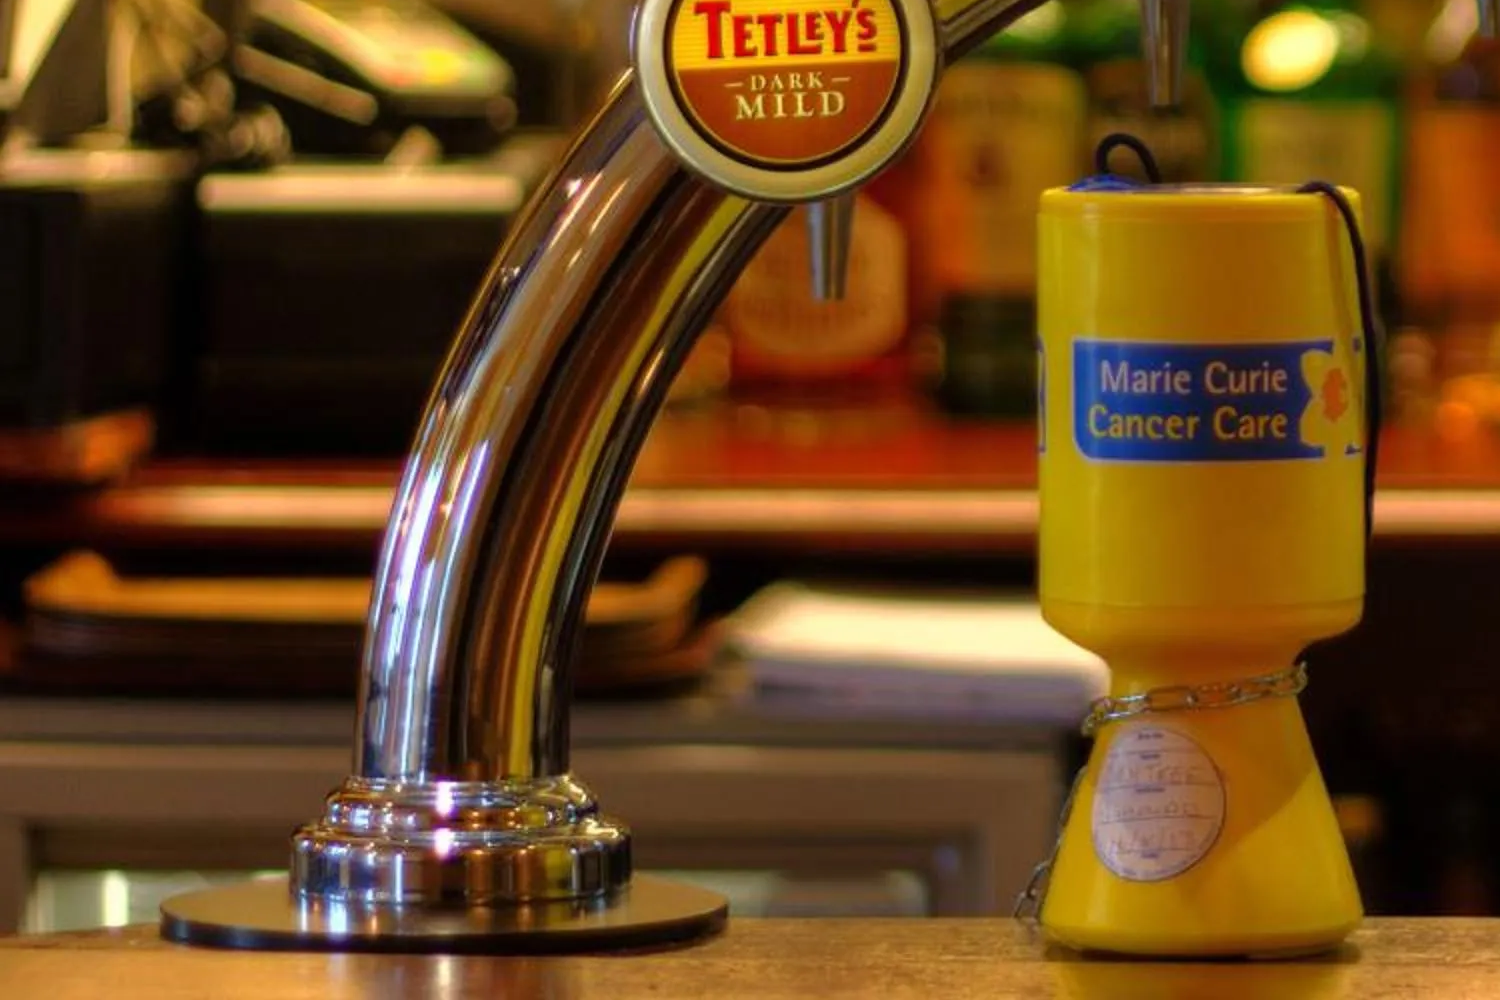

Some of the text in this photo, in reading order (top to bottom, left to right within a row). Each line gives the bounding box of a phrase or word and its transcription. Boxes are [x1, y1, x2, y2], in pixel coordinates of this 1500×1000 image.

[750, 71, 825, 93] DARK
[735, 90, 847, 121] MILD
[1100, 359, 1288, 394] Marie Curie
[1088, 403, 1288, 440] Cancer Care
